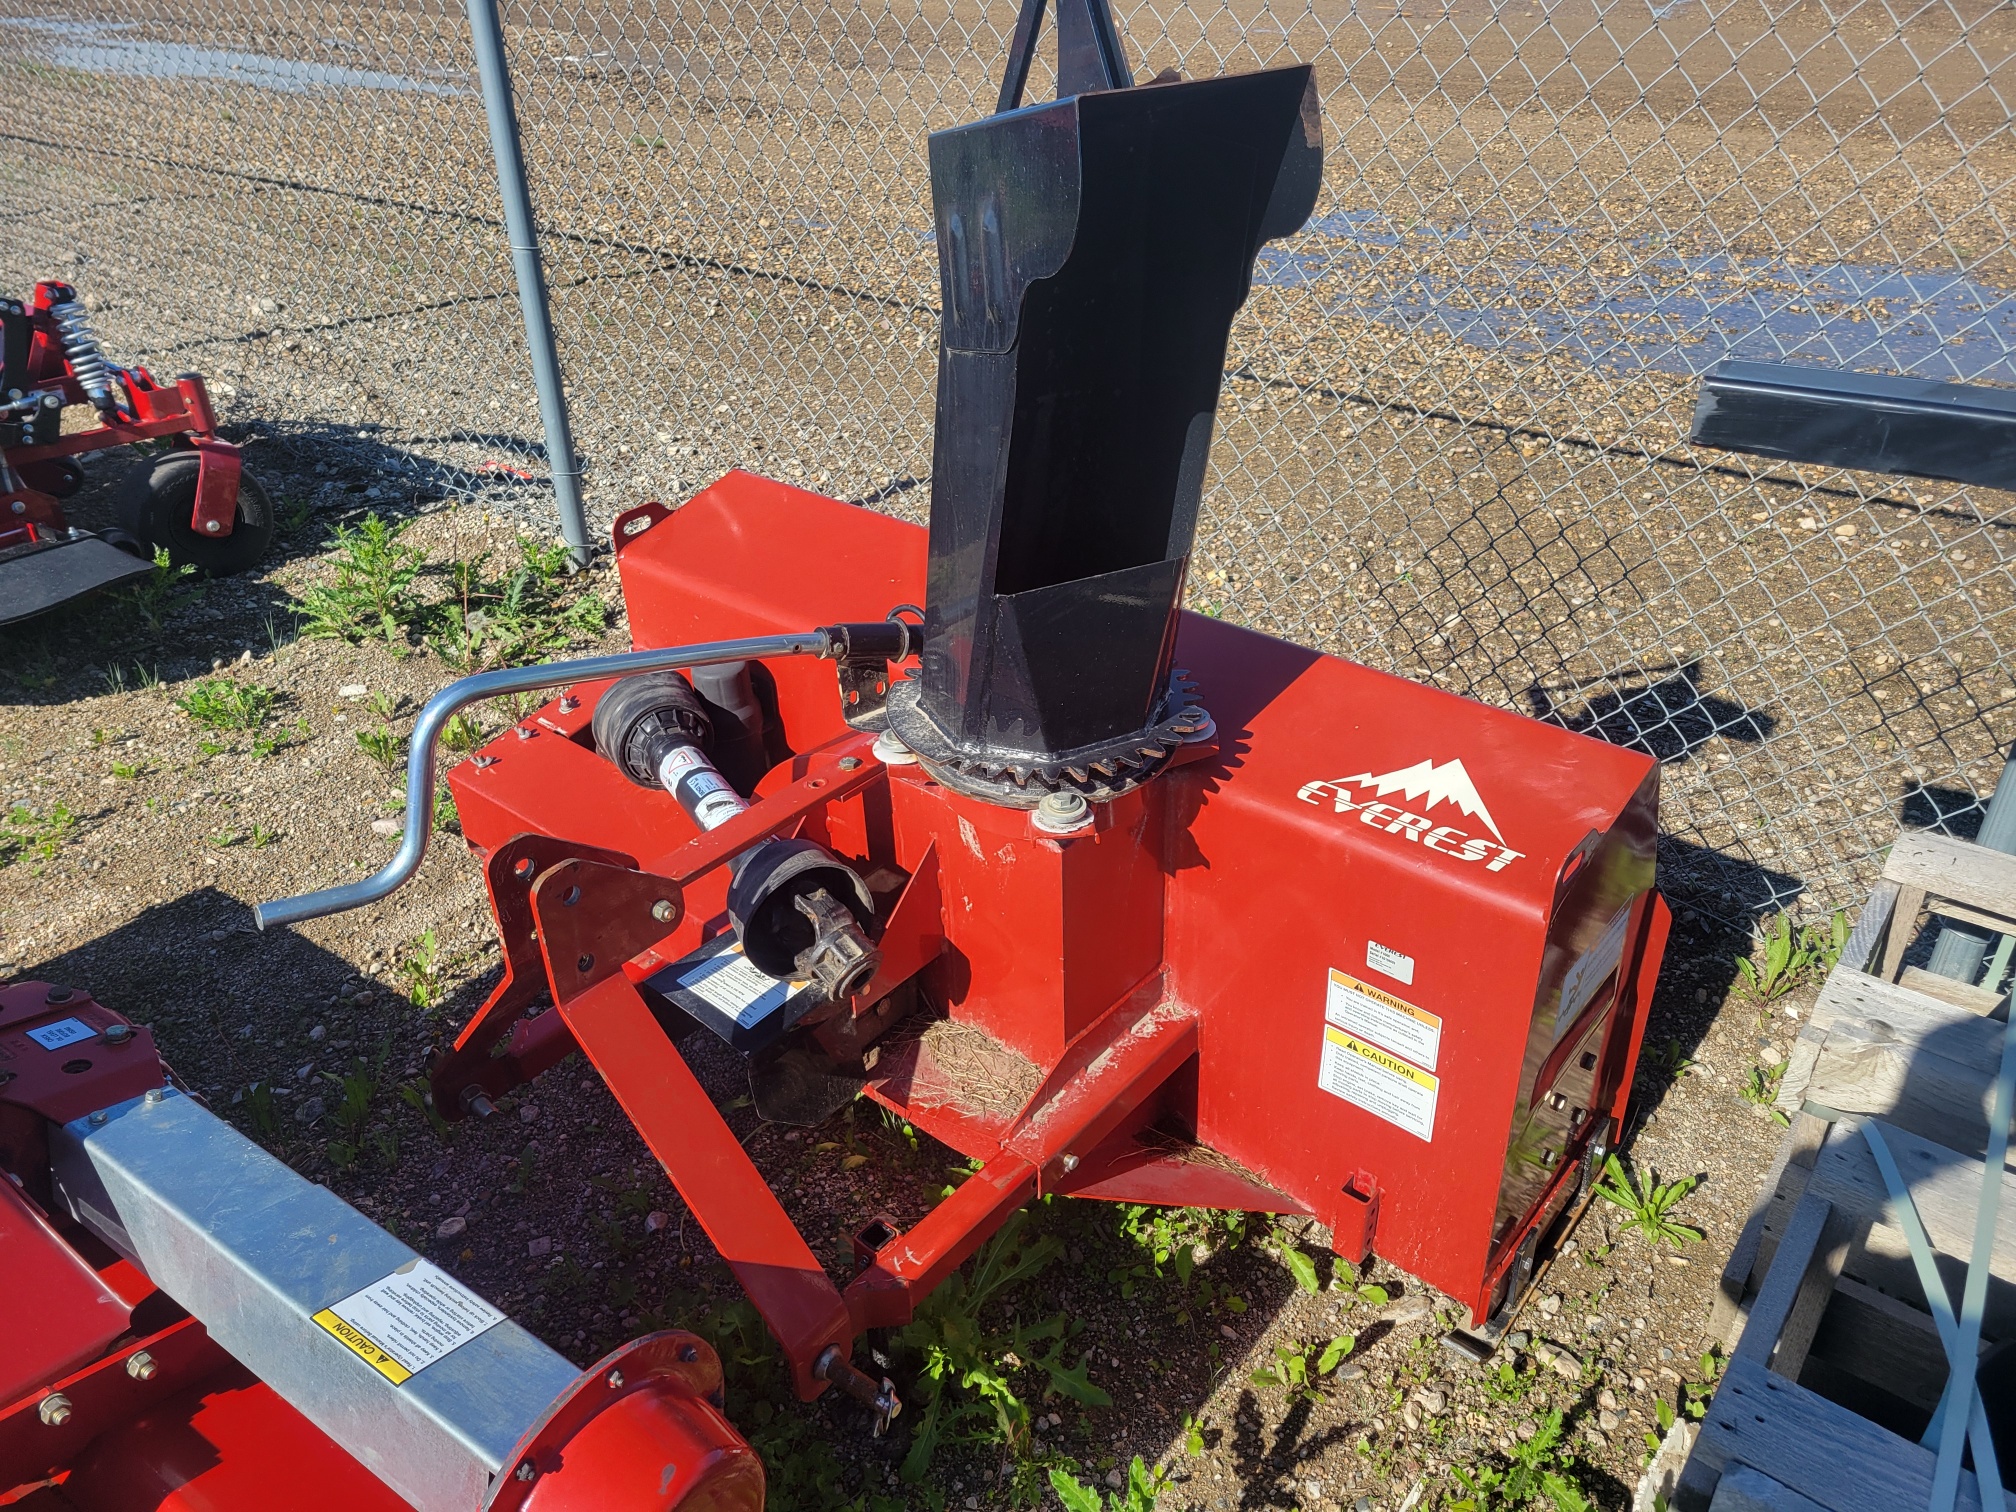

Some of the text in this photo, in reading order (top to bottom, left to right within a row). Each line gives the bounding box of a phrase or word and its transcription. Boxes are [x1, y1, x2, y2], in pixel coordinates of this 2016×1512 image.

[1297, 780, 1526, 872] EVEREST
[1367, 988, 1415, 1016] WARNING
[1362, 1047, 1414, 1079] CAUTION
[331, 1322, 376, 1355] CAUTION
